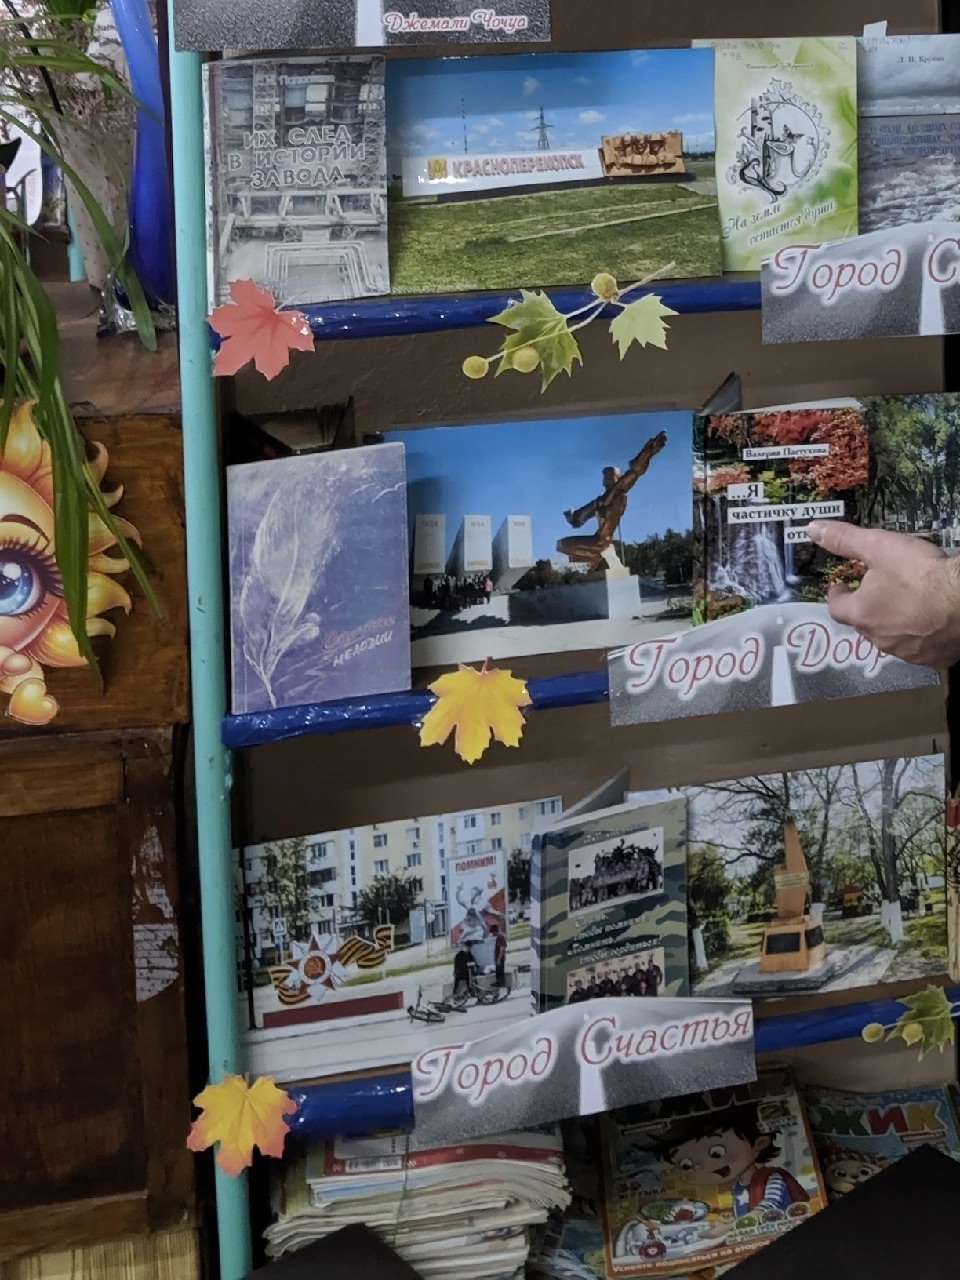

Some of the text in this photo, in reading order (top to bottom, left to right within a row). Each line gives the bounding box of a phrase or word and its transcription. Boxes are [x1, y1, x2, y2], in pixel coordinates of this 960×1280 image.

[384, 11, 527, 32] Джемали Чочуа
[243, 125, 353, 150] ИХ СЛЕД
[227, 143, 366, 170] В ИСТОРИИ
[452, 152, 585, 179] КРАСНОПЕРЕКОПСК
[251, 165, 346, 189] ЗАВОДА
[803, 201, 835, 224] душа
[721, 215, 748, 240] На
[773, 241, 903, 303] Город
[731, 502, 841, 522] частичку души
[629, 637, 761, 695] Город
[415, 1006, 752, 1102] Город Счастья
[813, 1100, 948, 1137] ЖИК
